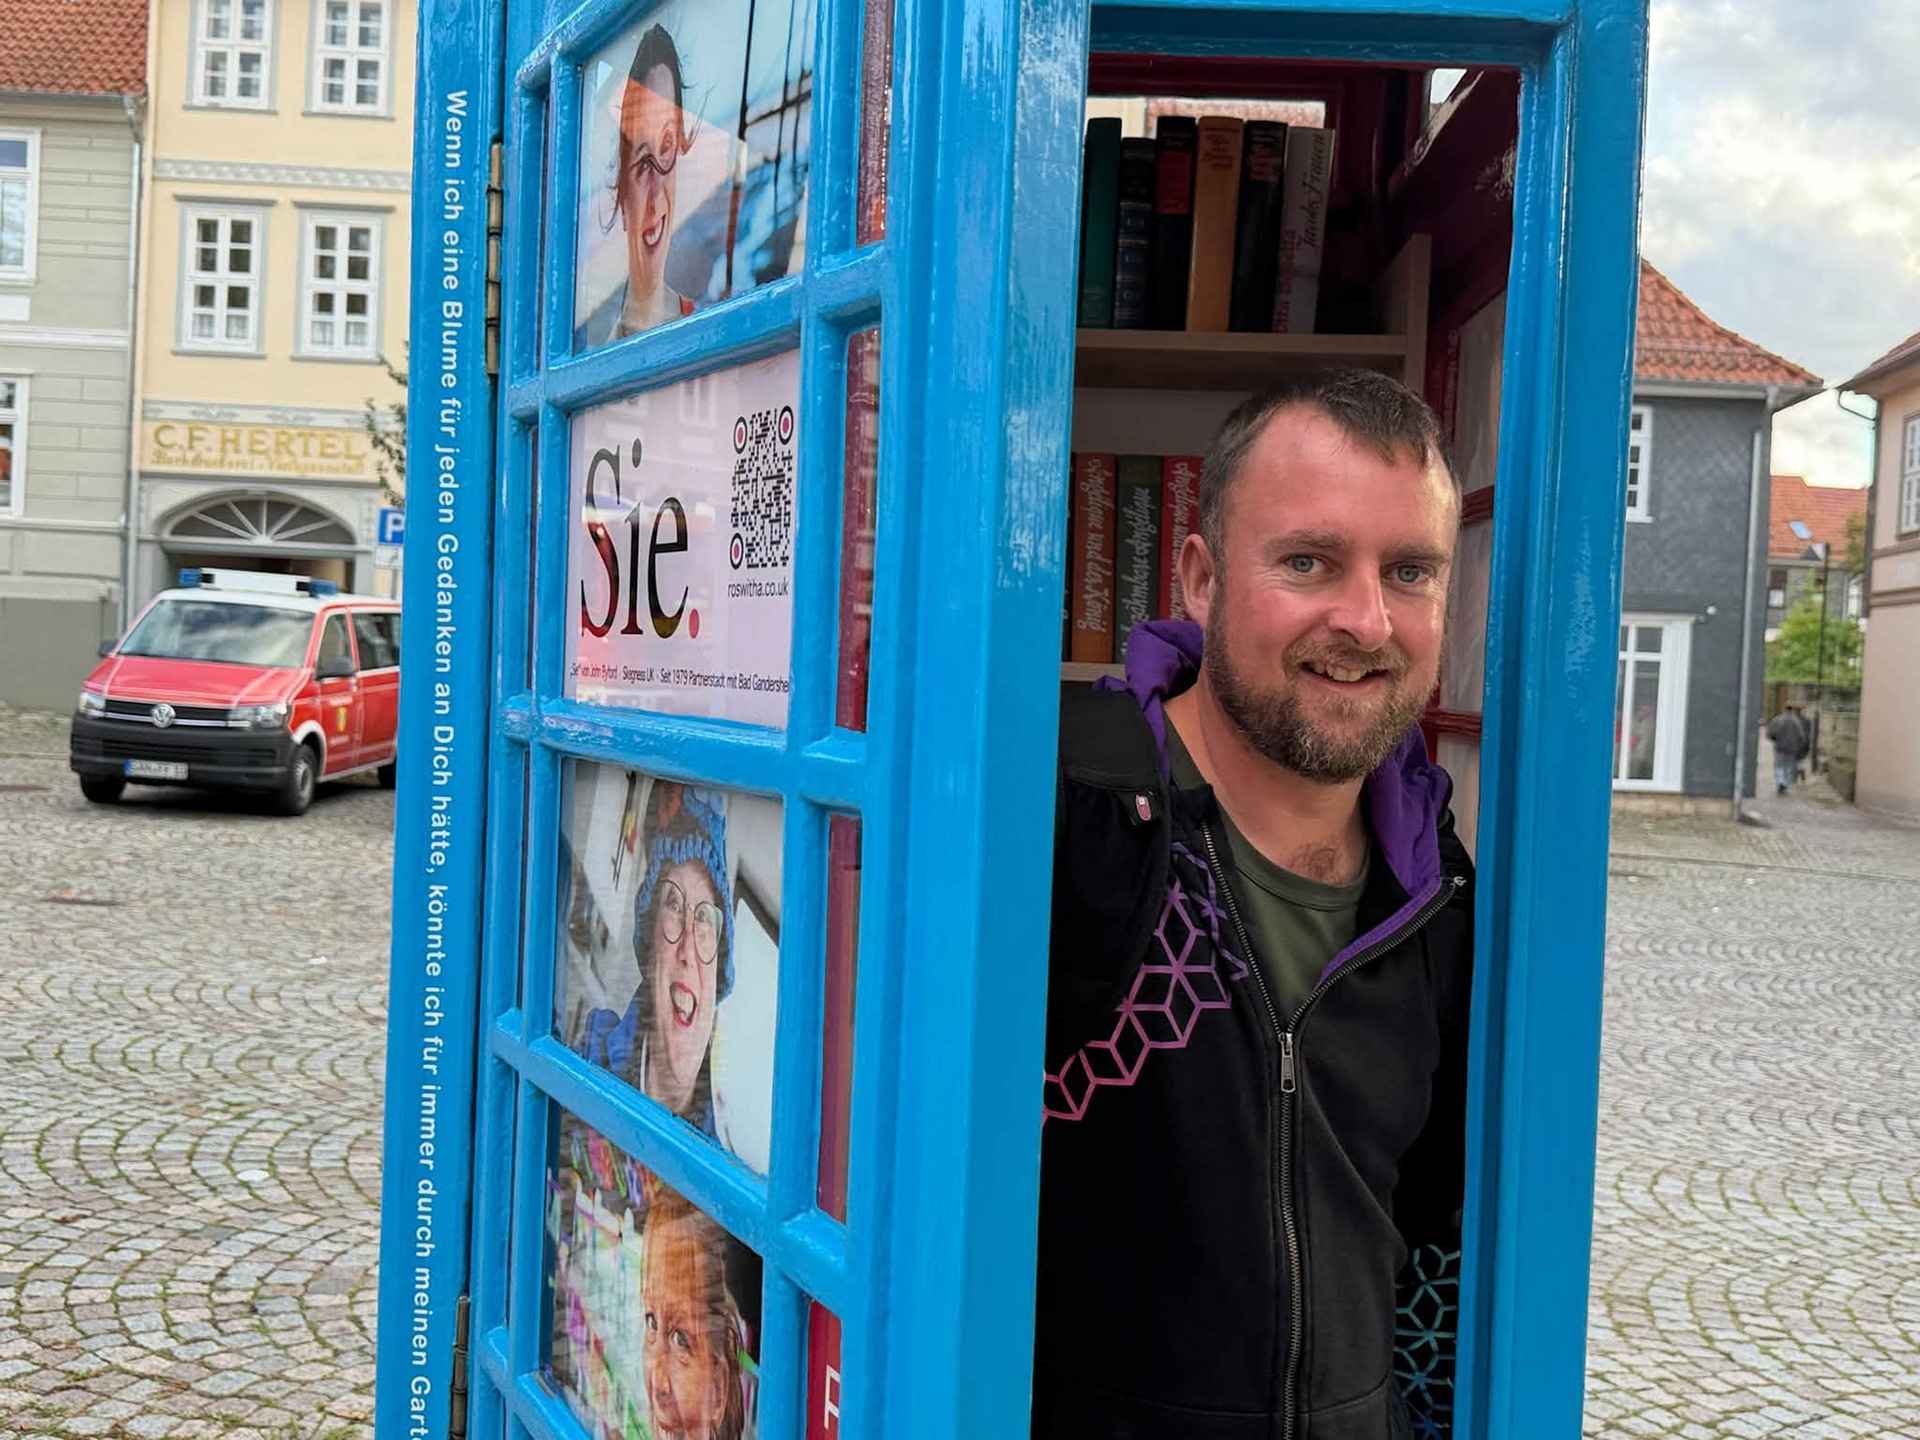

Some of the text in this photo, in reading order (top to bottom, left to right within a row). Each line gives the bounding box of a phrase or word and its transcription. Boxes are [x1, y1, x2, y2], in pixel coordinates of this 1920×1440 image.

[220, 427, 367, 460] HERTEL
[385, 512, 406, 541] P
[581, 437, 700, 639] Sie.
[1086, 531, 1113, 560] und
[727, 576, 789, 599] roswitha.co.uk
[646, 667, 656, 682] UK
[660, 668, 672, 684] Seit
[673, 669, 688, 686] 1979
[689, 670, 726, 688] Partnerstadt
[726, 673, 738, 690] mit
[738, 673, 752, 690] Bad
[409, 90, 467, 1440] Wenn ich eine Blume für jeden Gedanken an Dich hätte, könnte ich für immer durch meinen Gart
